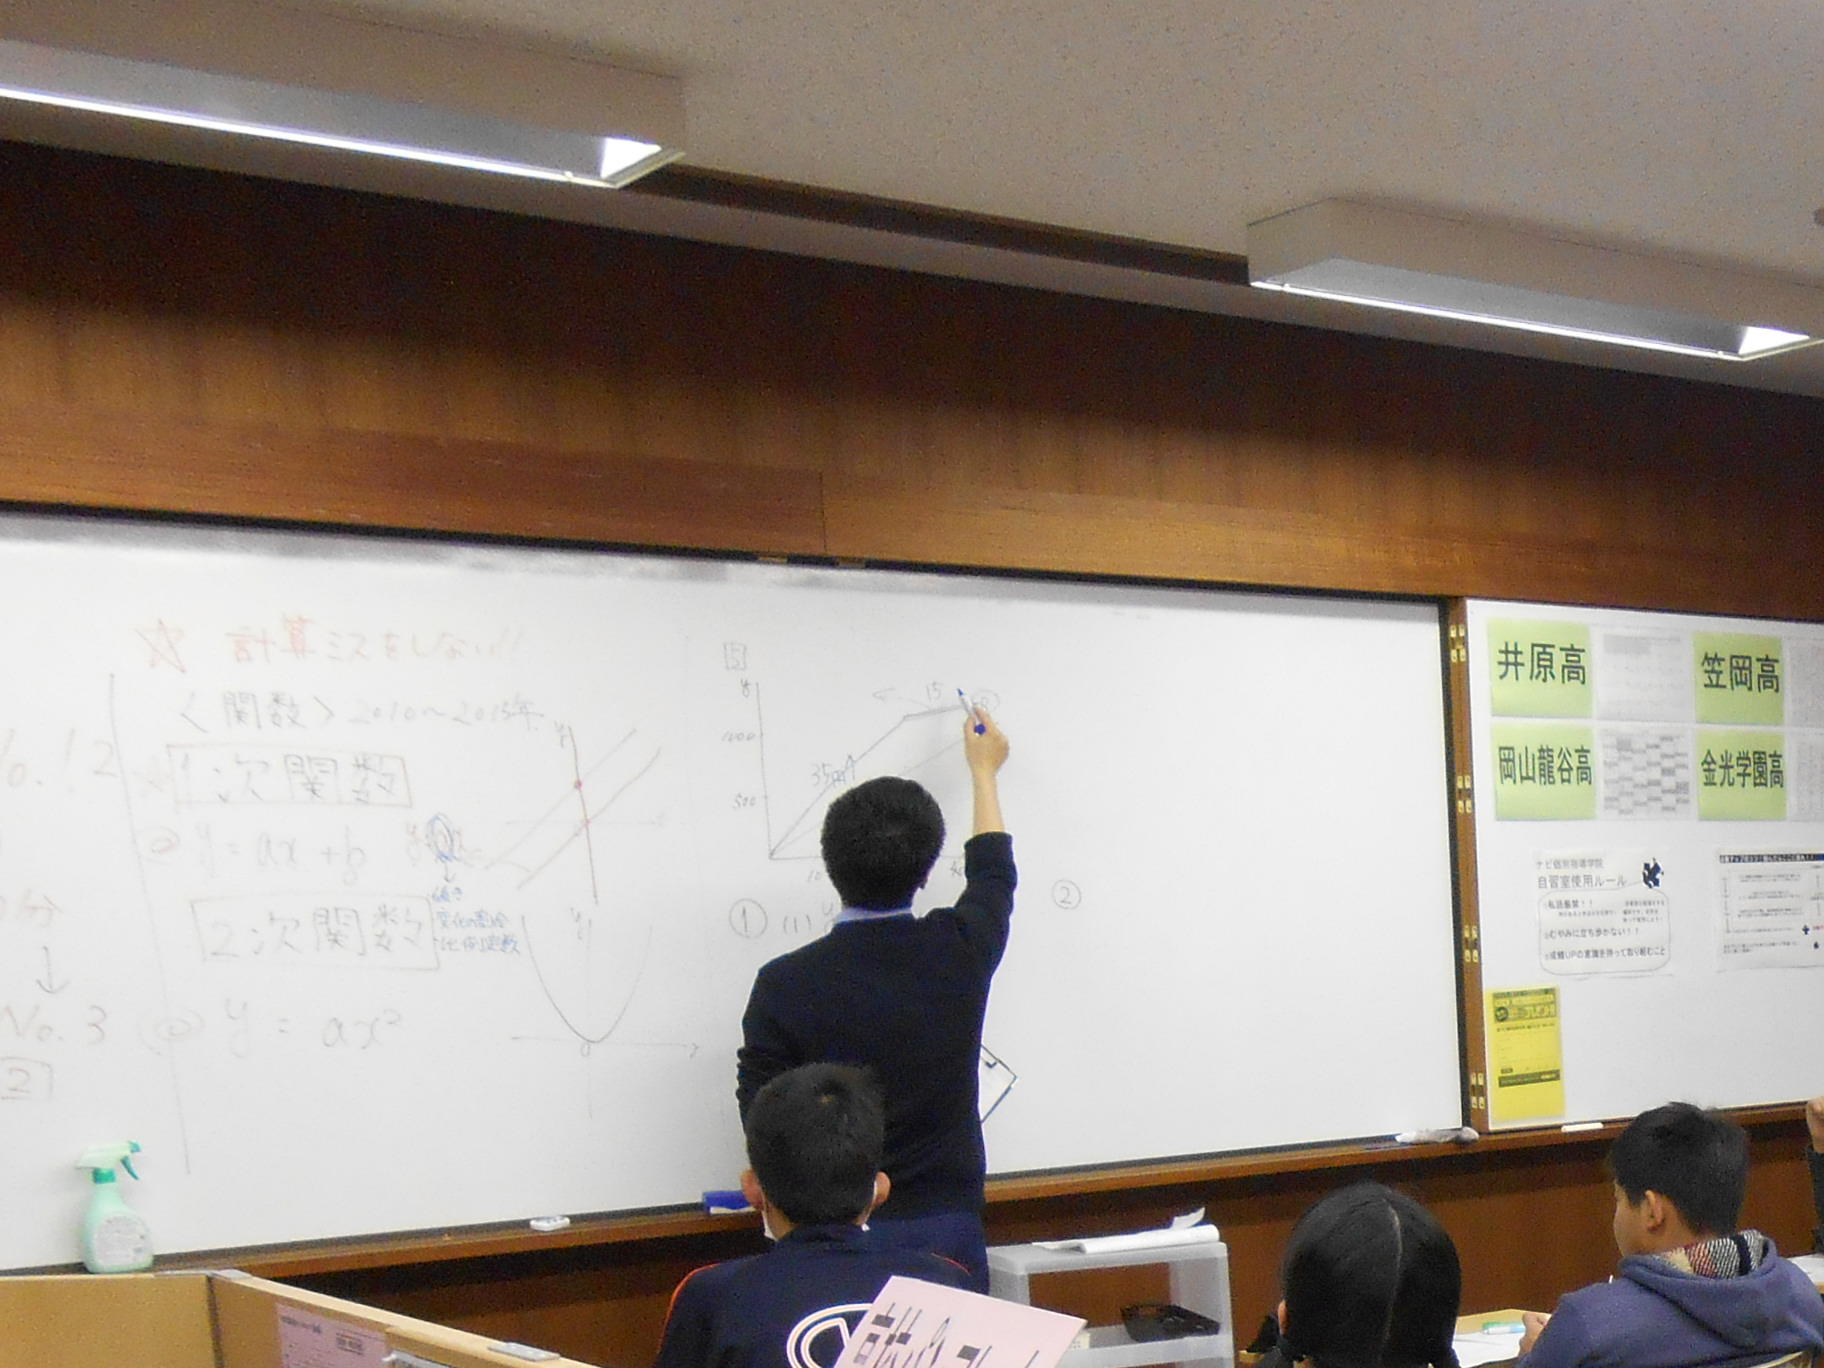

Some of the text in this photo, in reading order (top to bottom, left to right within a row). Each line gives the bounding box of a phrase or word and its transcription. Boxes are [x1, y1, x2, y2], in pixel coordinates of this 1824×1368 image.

[1498, 641, 1587, 685] 井原高
[1701, 651, 1781, 693] 笠岡高
[1498, 745, 1593, 786] 岡山龍谷高
[1701, 749, 1784, 789] 金光学園高
[1538, 874, 1627, 889] 自習室使用ルール
